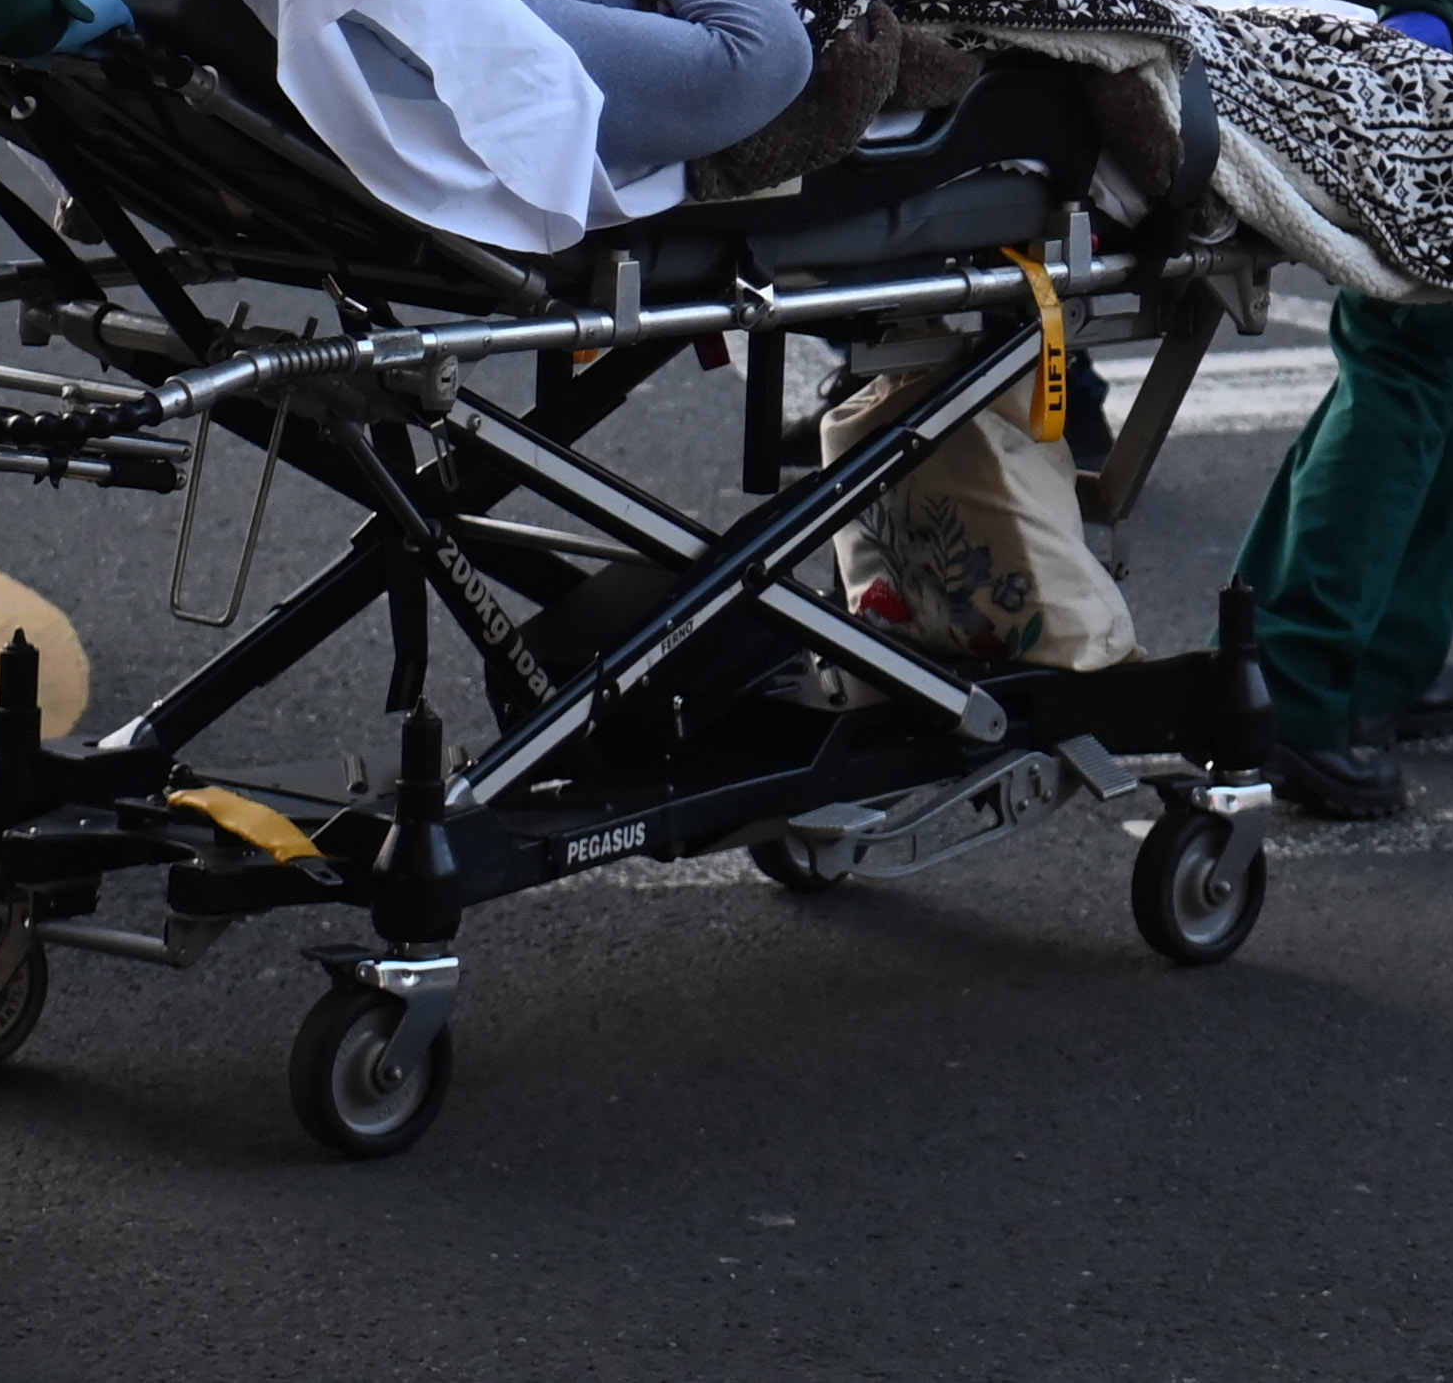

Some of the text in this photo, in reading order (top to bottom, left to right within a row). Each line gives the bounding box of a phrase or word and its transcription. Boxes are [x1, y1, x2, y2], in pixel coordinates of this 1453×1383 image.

[1048, 343, 1062, 411] LIFT
[660, 618, 695, 656] FERNO
[567, 821, 646, 865] PEGASUS
